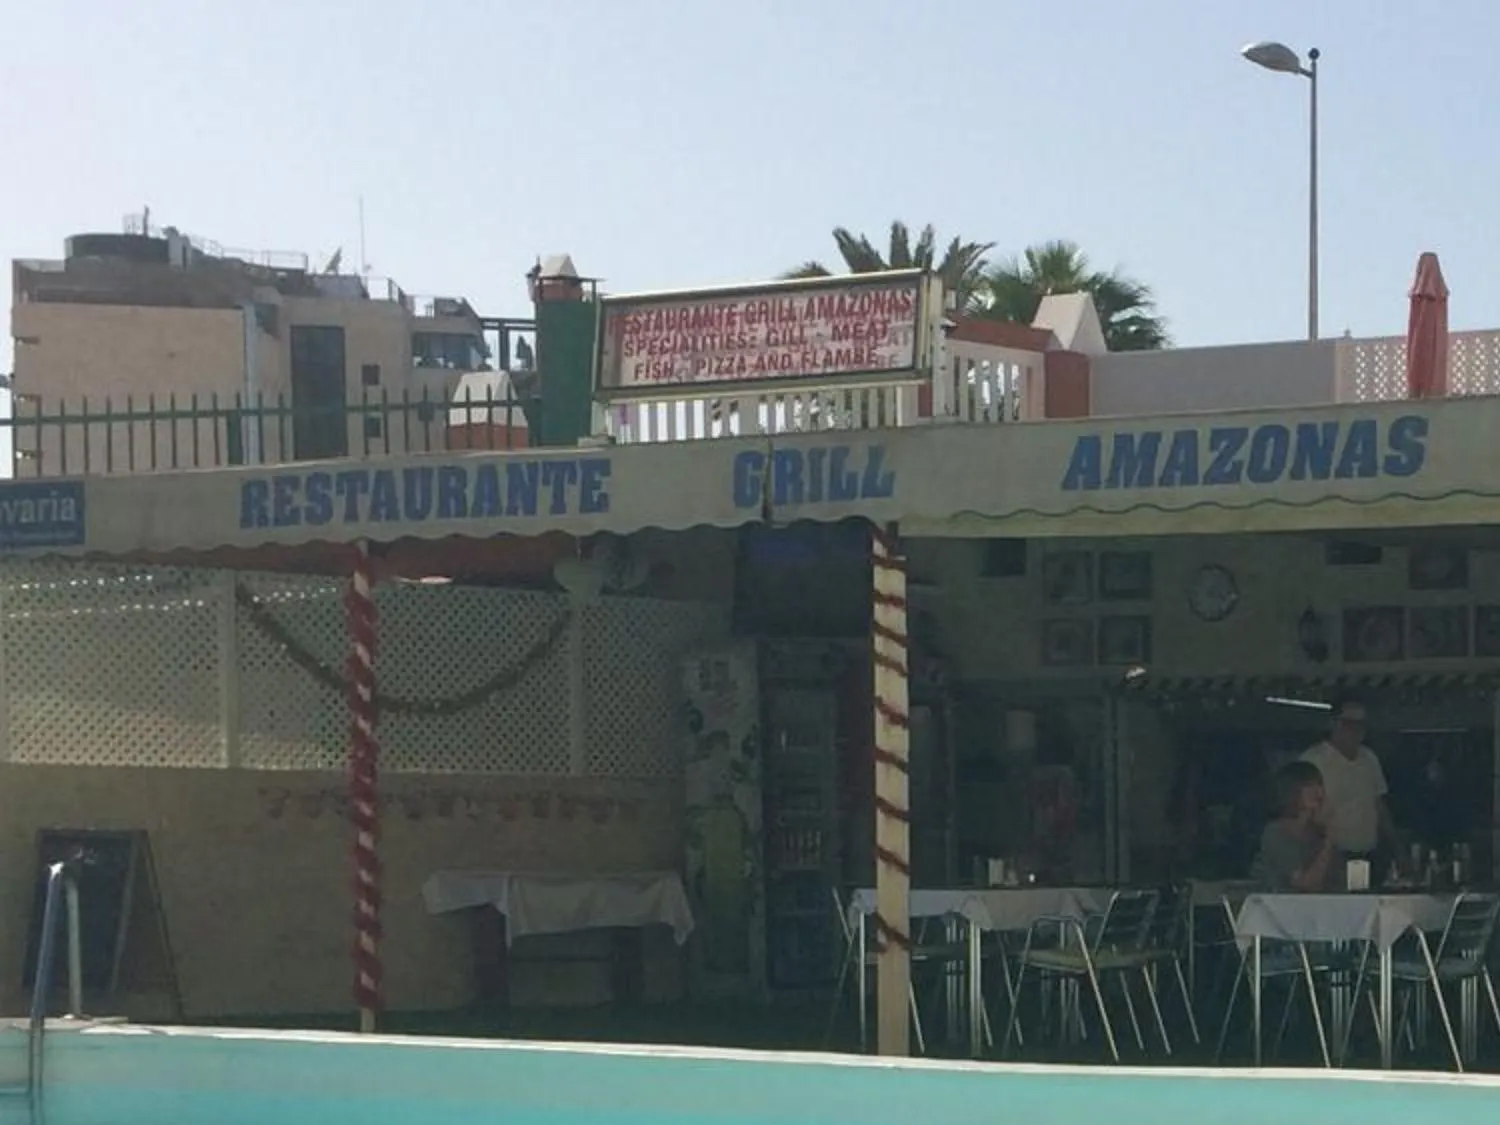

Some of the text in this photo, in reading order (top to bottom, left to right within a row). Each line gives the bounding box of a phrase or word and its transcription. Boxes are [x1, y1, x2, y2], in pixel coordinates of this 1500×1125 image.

[609, 288, 912, 335] RESTAURANTE GRILL AMAZONAS
[831, 319, 888, 341] MEAT
[634, 356, 674, 380] FISH
[696, 355, 746, 375] PIZZA
[755, 353, 793, 372] AND
[239, 414, 1429, 529] RESTAURANTE GRILL AMAZONAS
[0, 489, 76, 525] varia
